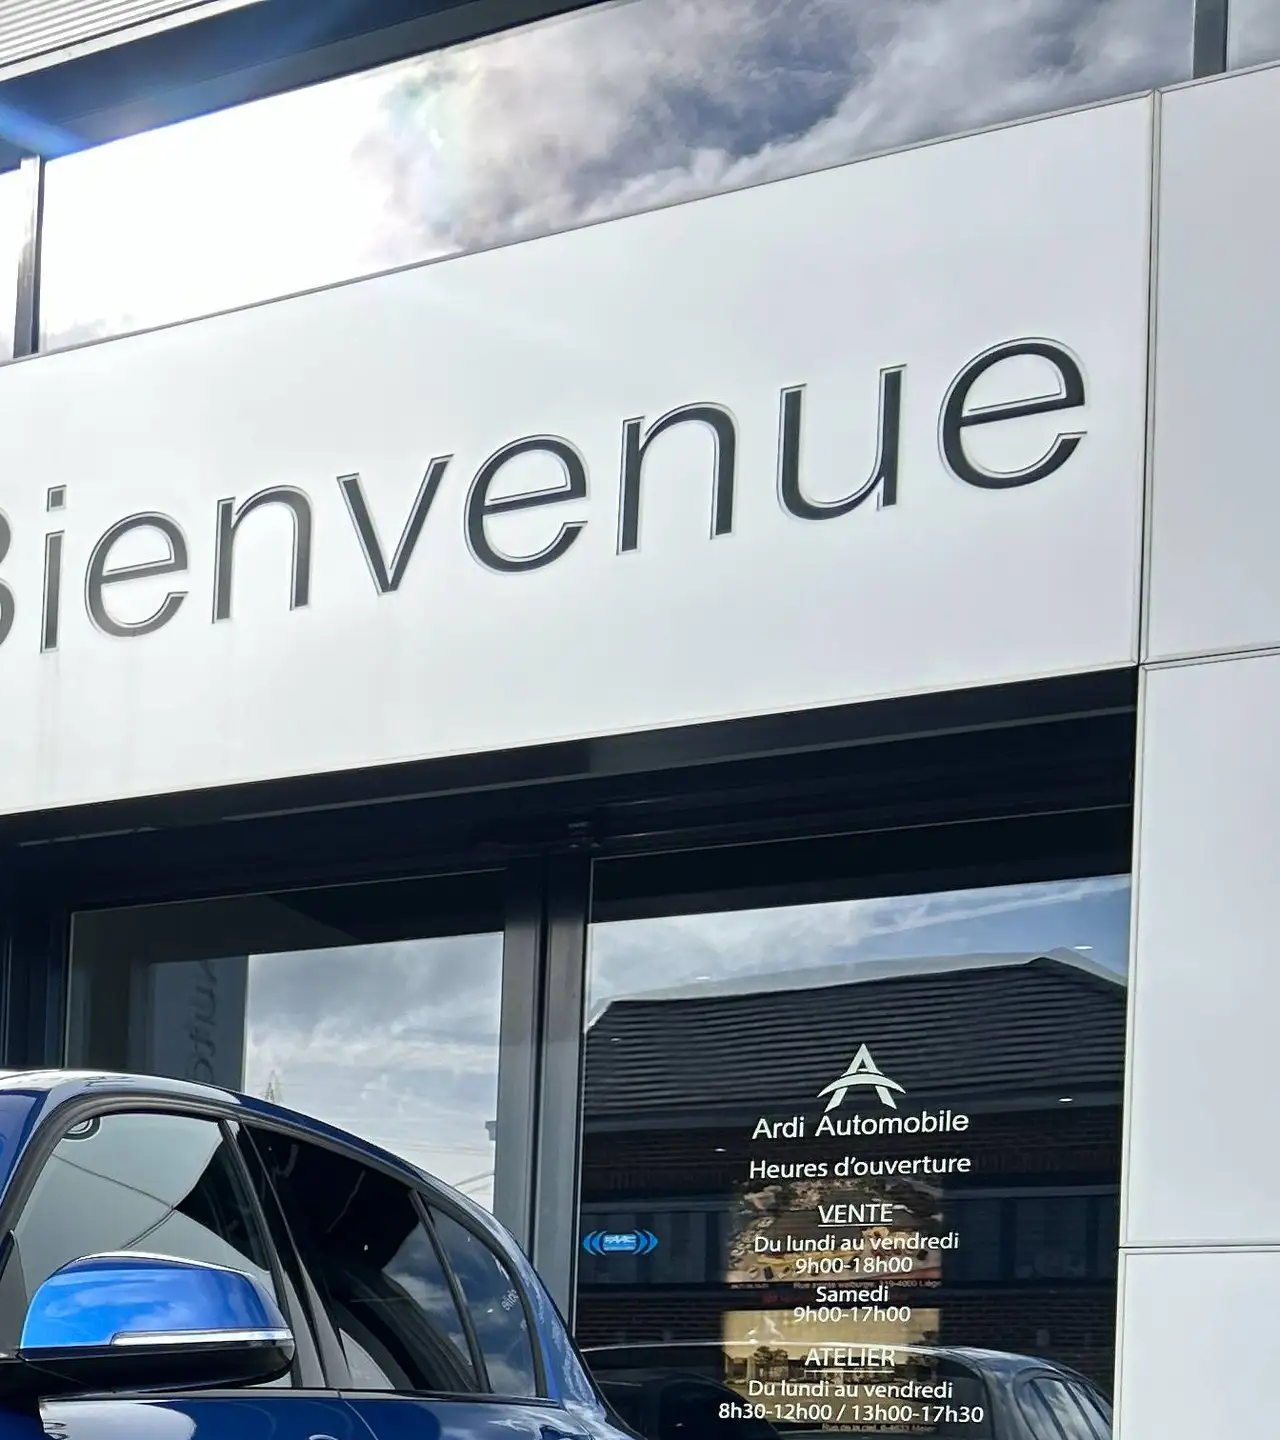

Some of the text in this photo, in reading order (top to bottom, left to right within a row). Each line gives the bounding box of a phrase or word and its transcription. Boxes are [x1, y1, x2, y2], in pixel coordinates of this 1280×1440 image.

[752, 1109, 968, 1139] Ardi Automobile
[750, 1160, 827, 1178] Heures
[818, 1204, 892, 1223] VENTE
[755, 1230, 958, 1252] Du lundi au vendredi
[796, 1256, 912, 1273] 9h00-18h00
[817, 1286, 888, 1302] Samedi
[794, 1306, 910, 1322] 9h00-17h00
[805, 1347, 896, 1366] ATELIER
[749, 1380, 952, 1398] Du lundi au vendredi
[719, 1403, 983, 1422] 8h30-12h00 / 13h00-17h30
